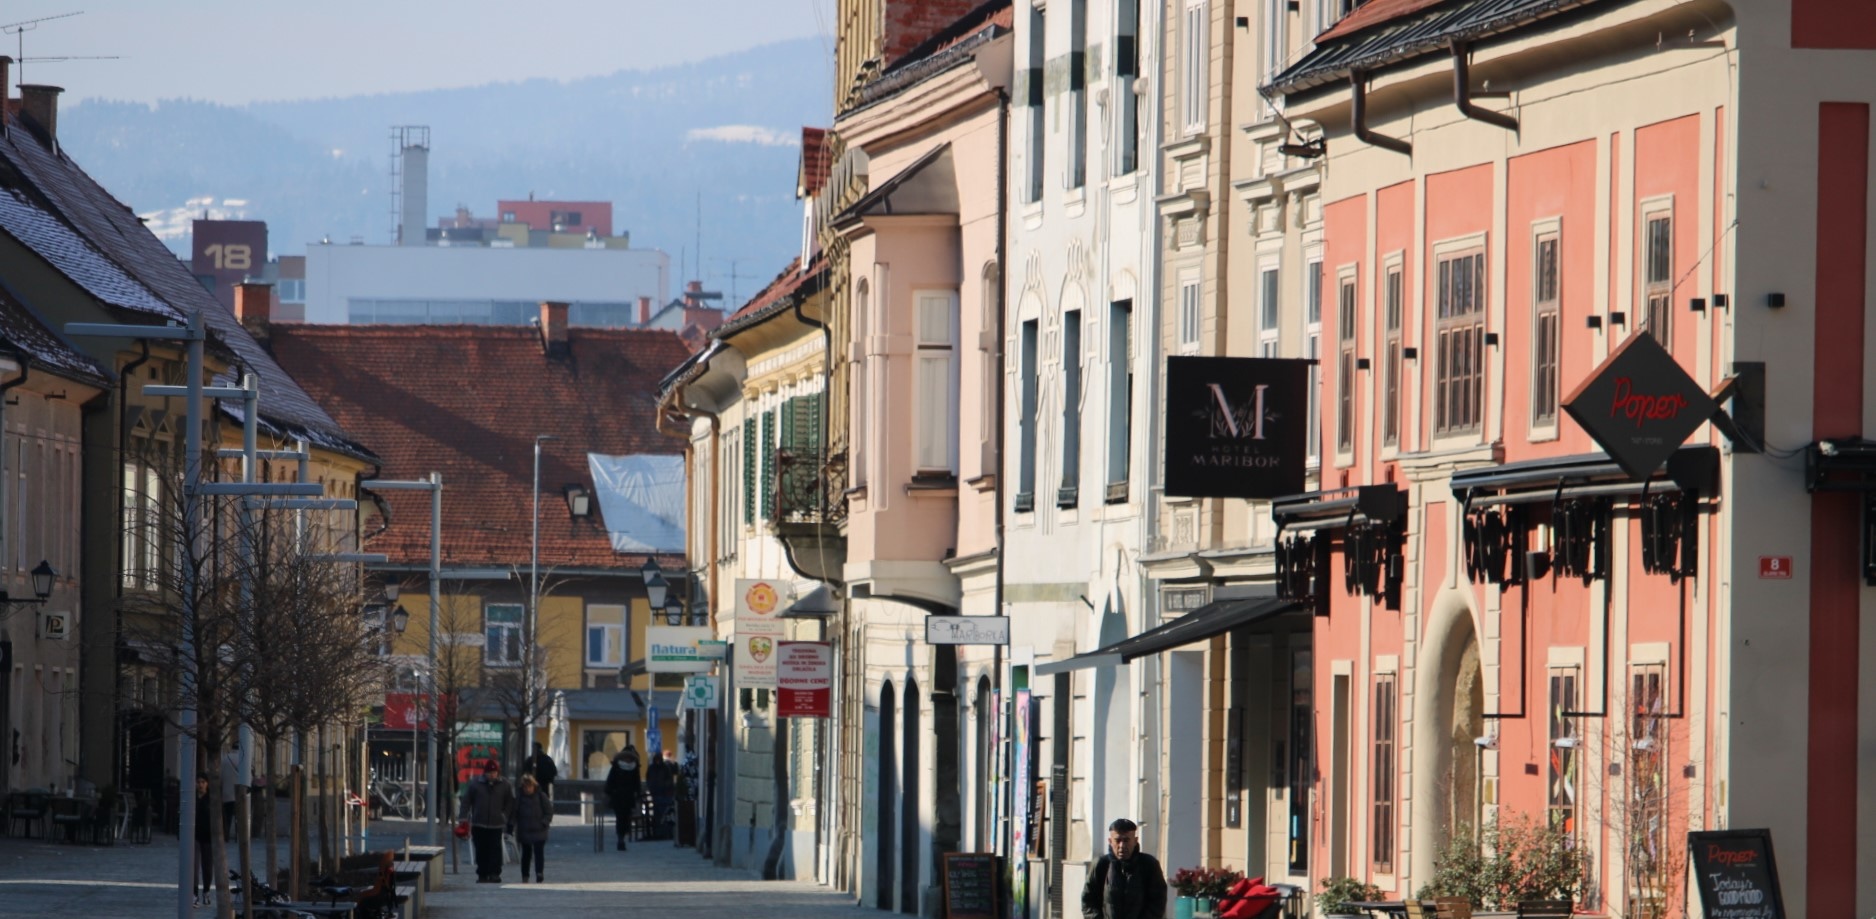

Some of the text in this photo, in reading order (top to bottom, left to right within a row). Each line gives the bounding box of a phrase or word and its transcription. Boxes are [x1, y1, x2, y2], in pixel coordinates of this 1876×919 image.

[203, 244, 251, 269] 18
[1206, 383, 1269, 440] M
[1610, 376, 1689, 429] Poper
[1211, 445, 1260, 454] HOTEL
[1192, 455, 1281, 467] MARIBOR
[1771, 558, 1780, 571] 8
